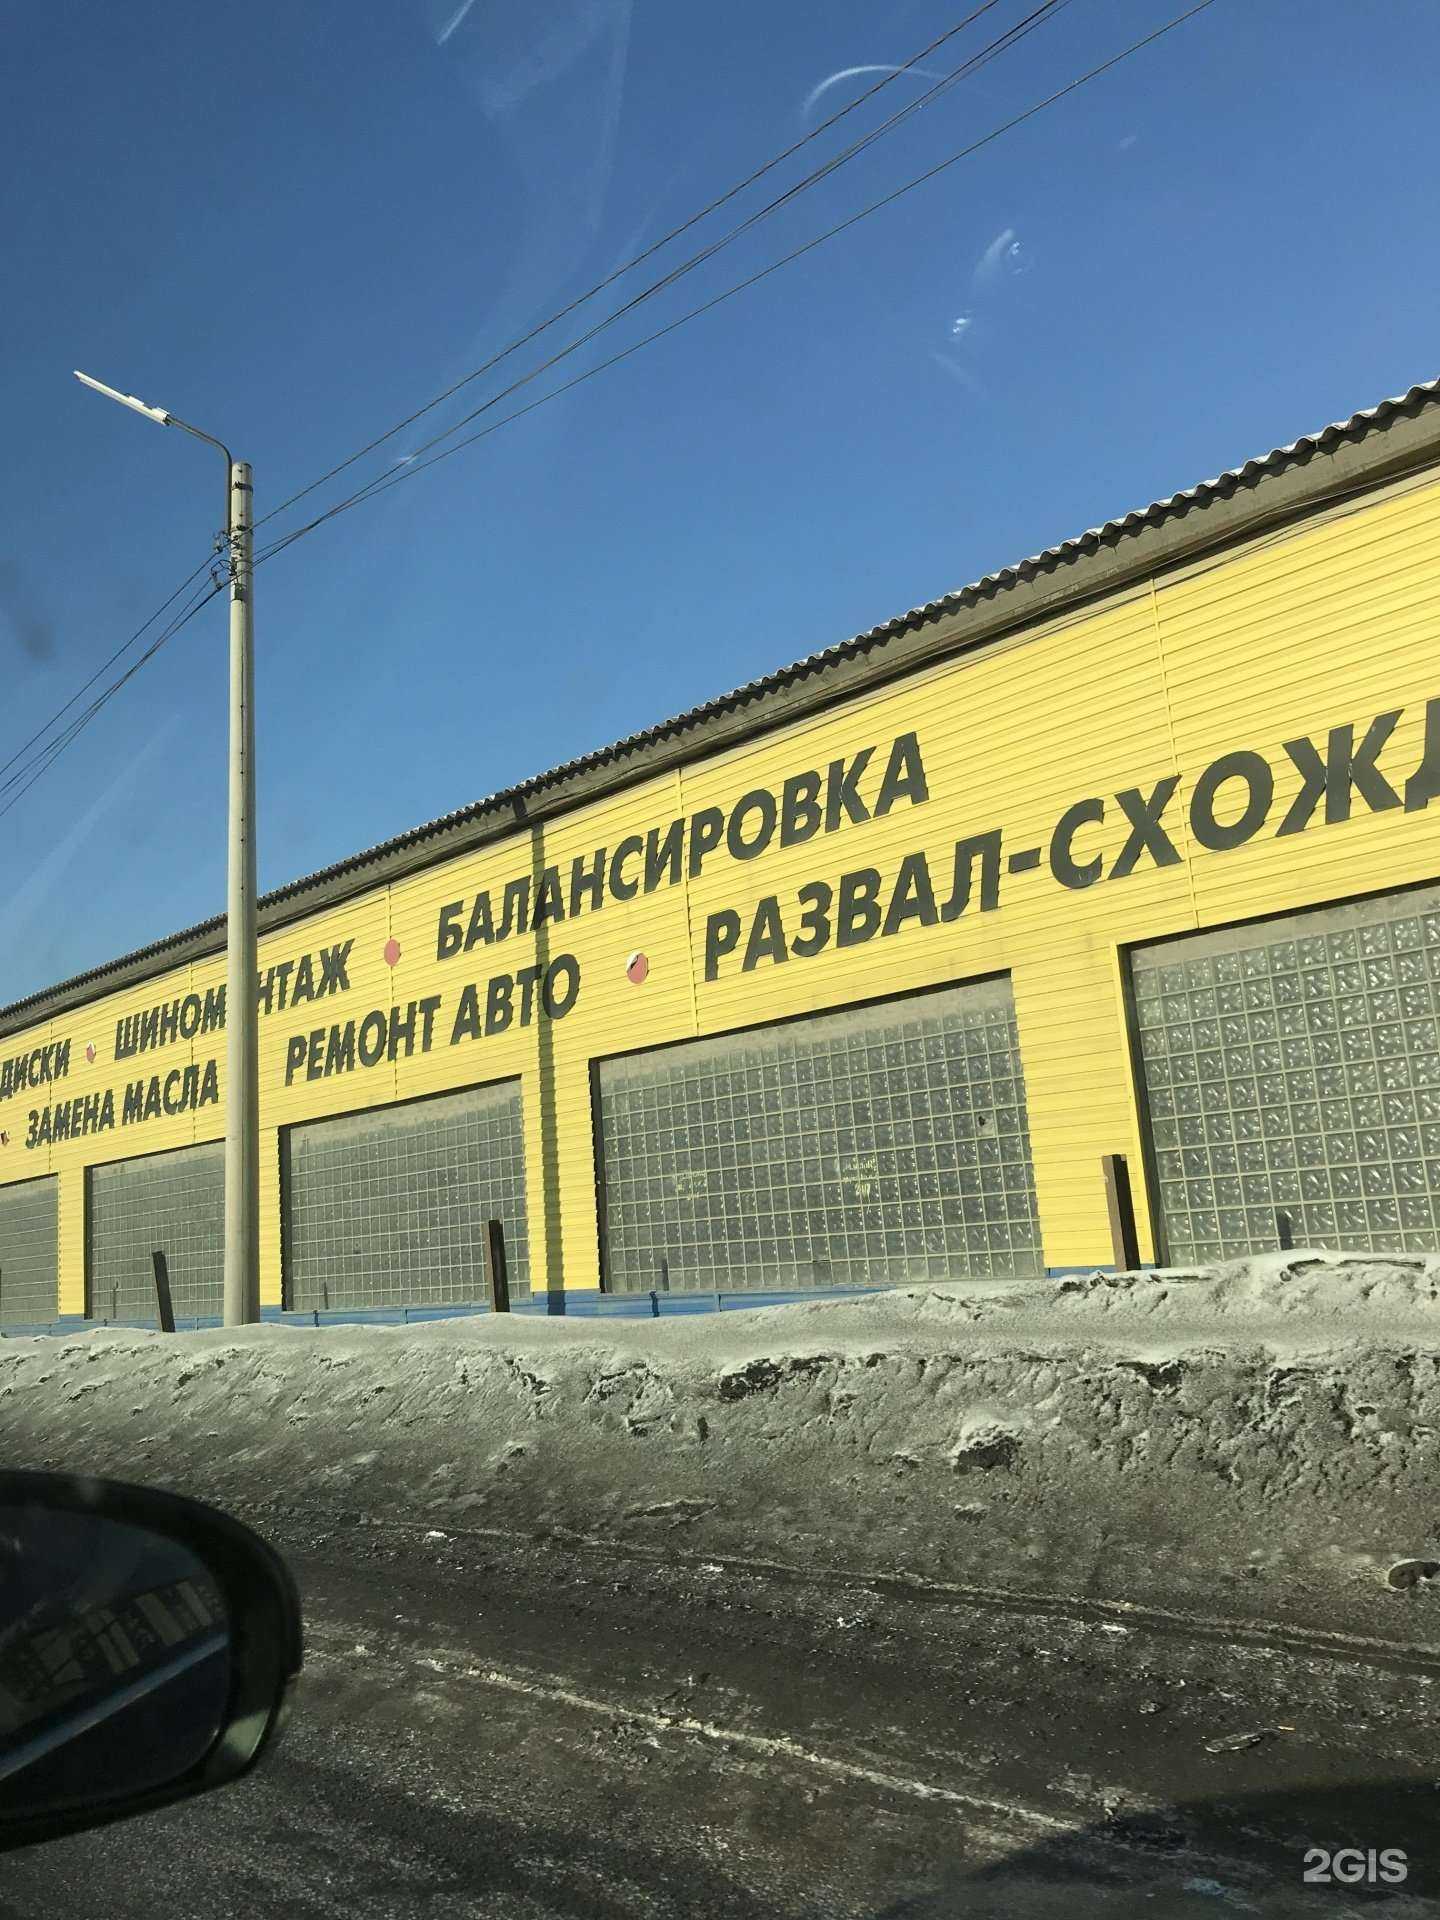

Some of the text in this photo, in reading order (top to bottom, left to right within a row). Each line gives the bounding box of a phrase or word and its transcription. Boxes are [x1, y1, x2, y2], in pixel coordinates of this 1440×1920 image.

[0, 731, 929, 1100] ДИСКИ ШИНОМНТАЖ БАЛАНСИРОВКА
[25, 1089, 115, 1149] ЗАМЕНА
[122, 1059, 219, 1126] МАСЛА
[285, 995, 442, 1087] РЕМОНТ
[450, 953, 581, 1046] АВТО
